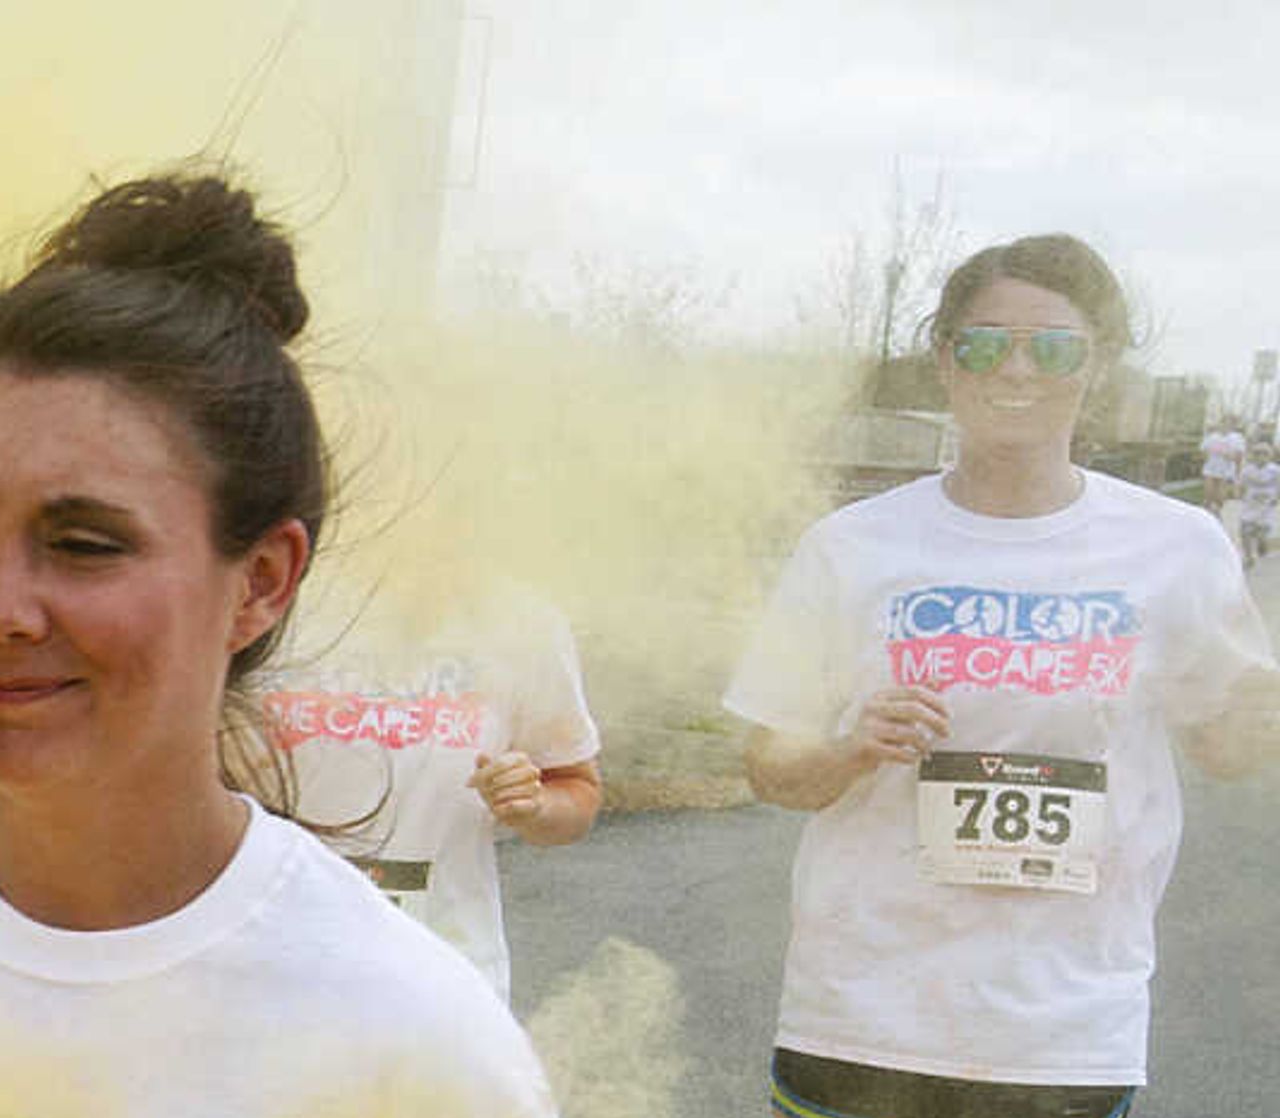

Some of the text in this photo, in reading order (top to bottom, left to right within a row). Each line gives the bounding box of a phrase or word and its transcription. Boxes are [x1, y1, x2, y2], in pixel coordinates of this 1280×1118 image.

[905, 592, 1120, 643] COLOR
[902, 646, 955, 683] ME
[965, 646, 1077, 686] CAPE
[324, 703, 423, 741] CAPE
[954, 787, 1072, 847] 785
